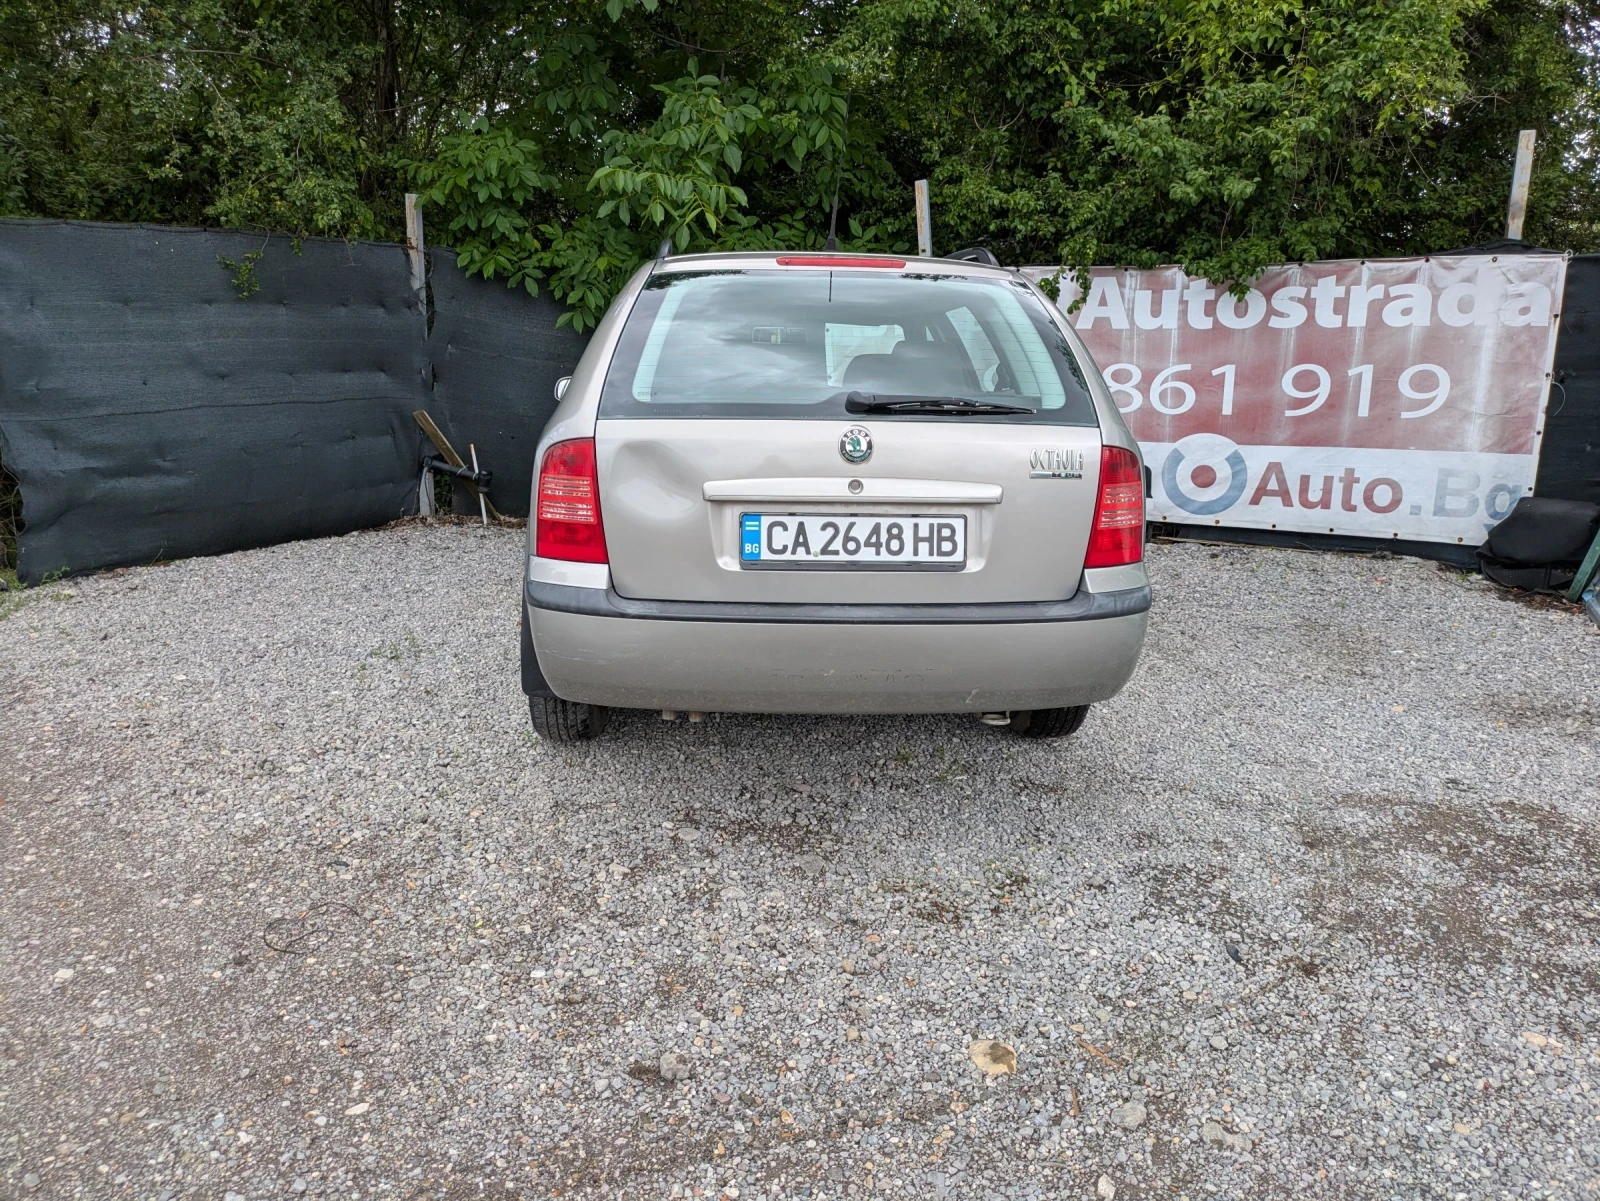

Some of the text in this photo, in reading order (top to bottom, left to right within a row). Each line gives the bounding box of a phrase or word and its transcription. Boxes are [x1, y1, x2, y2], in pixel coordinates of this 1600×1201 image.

[1075, 268, 1551, 330] Autostrada
[1102, 363, 1451, 419] 861 919
[1029, 448, 1084, 470] OCTAVIA
[744, 543, 759, 553] BG
